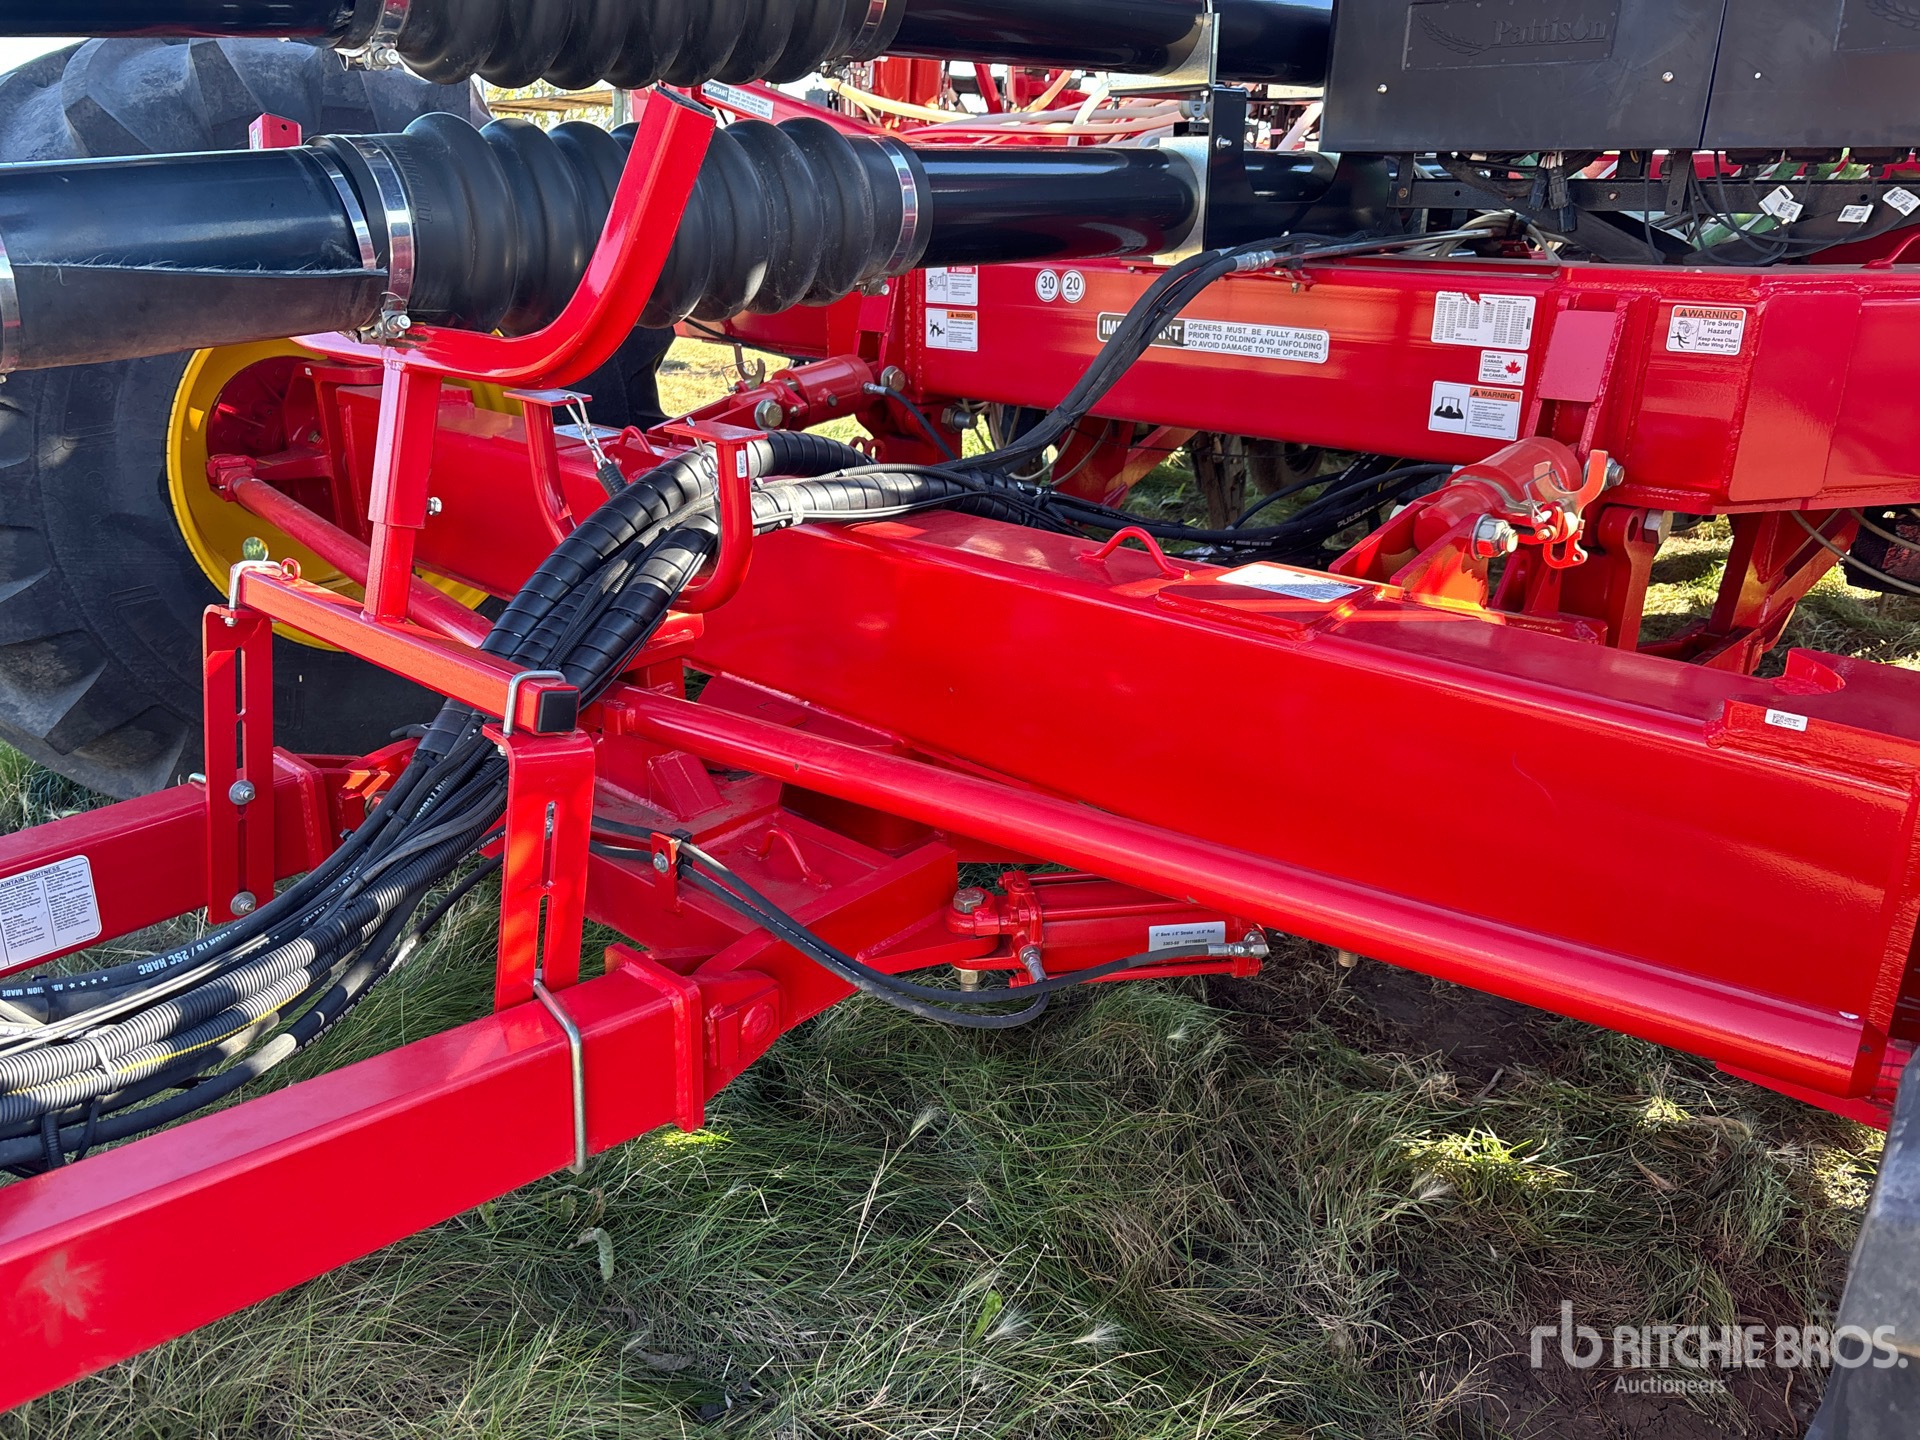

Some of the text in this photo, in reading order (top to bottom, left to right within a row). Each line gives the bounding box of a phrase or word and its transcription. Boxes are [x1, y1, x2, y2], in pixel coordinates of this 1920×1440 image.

[1491, 15, 1606, 45] Pattison
[1041, 275, 1055, 289] 30
[1066, 276, 1080, 290] 20
[1688, 310, 1738, 319] WARNING
[1717, 320, 1740, 328] Swing
[1188, 323, 1323, 341] OPENERS MUST BE FULLY RAISED
[1188, 331, 1210, 339] PRIOR
[1224, 334, 1257, 344] FOLDING
[1259, 337, 1275, 346] AND
[1278, 339, 1322, 351] UNFOLDING
[1198, 340, 1220, 349] AVOID
[1221, 342, 1253, 353] DAMAGE
[1255, 346, 1265, 354] TO
[1266, 347, 1281, 355] THE
[1282, 348, 1321, 360] OPENERS.
[1481, 390, 1516, 400] WARNING
[26, 865, 60, 882] TIGHTNESS
[168, 950, 189, 965] 2SC
[138, 958, 168, 975] HARC
[2, 988, 23, 997] MADE
